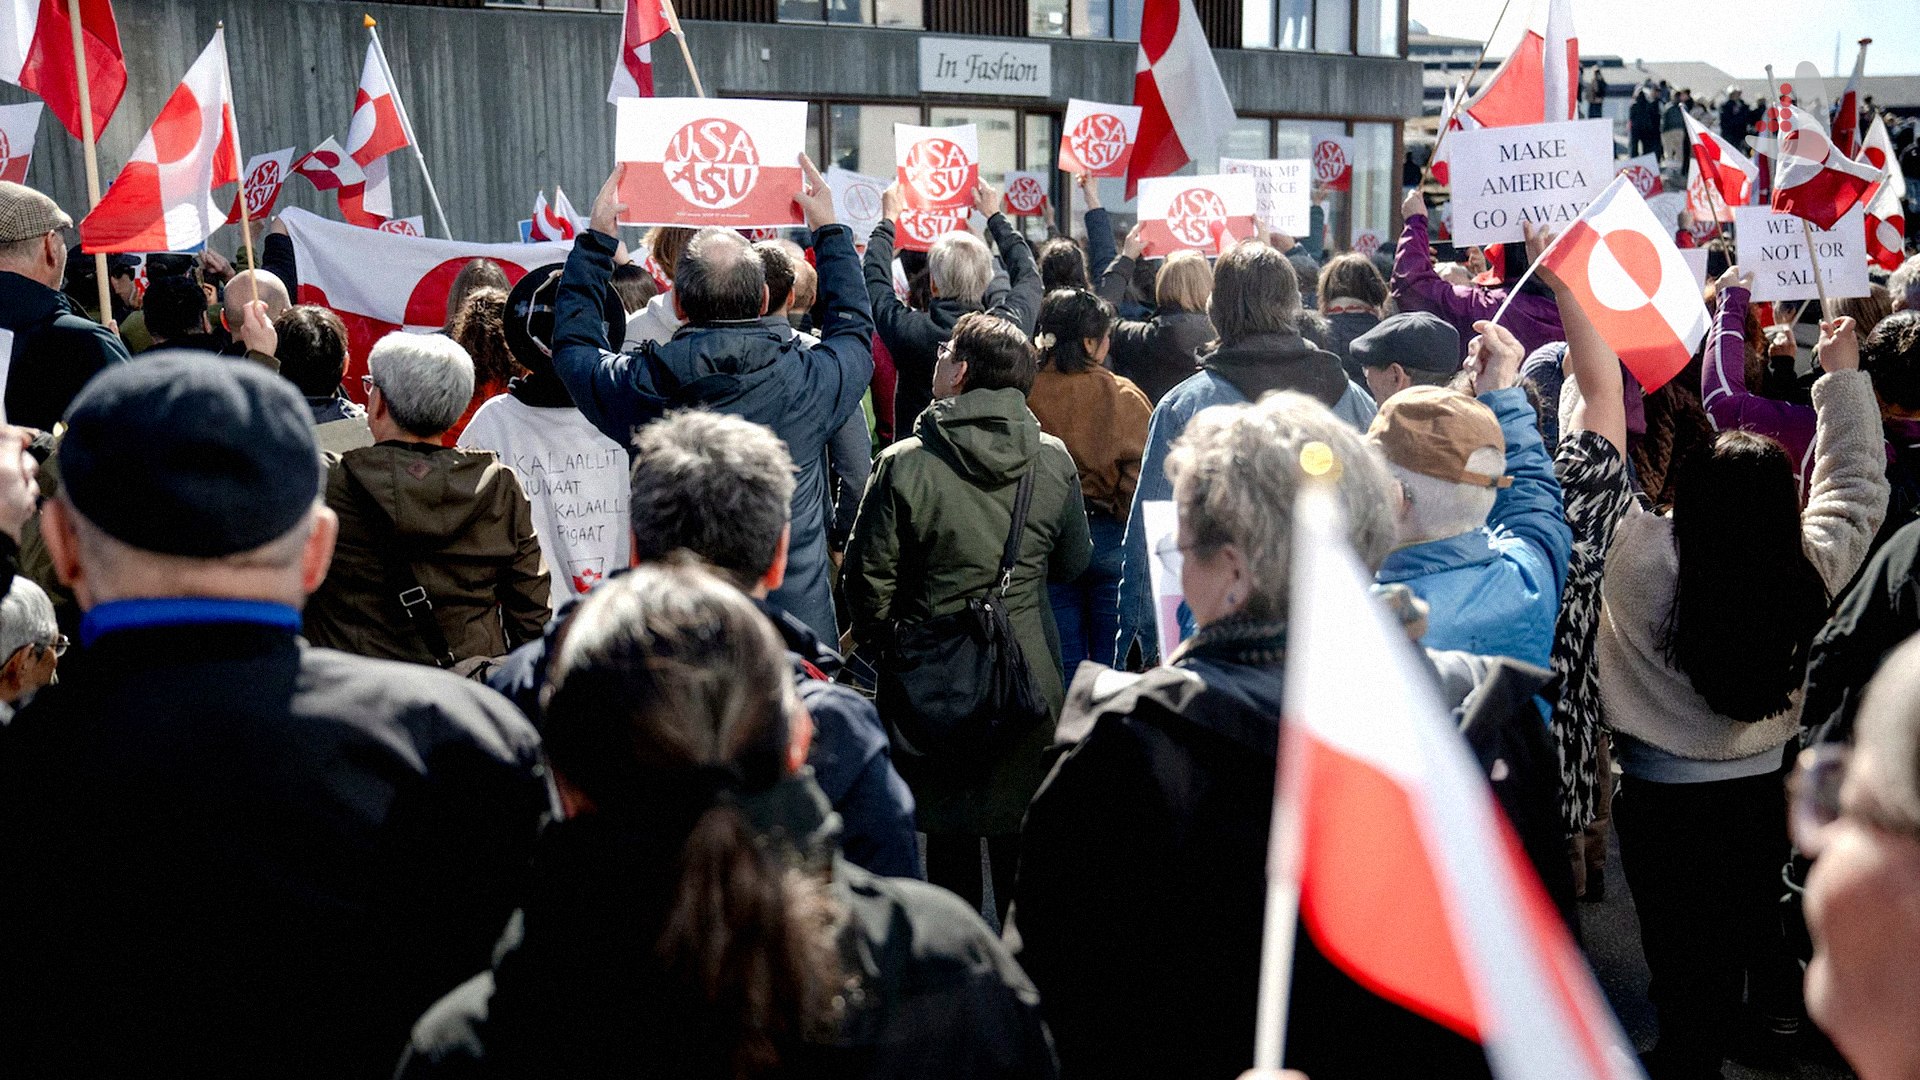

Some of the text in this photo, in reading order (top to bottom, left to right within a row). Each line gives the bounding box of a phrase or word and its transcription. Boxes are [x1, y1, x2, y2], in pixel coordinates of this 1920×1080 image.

[935, 51, 1039, 84] In Fashion
[1078, 115, 1125, 142] USA
[672, 120, 755, 166] USA
[1499, 139, 1567, 163] MAKE
[671, 162, 753, 205] ASU
[1480, 170, 1588, 197] AMERICA
[1472, 208, 1508, 230] GO
[1766, 218, 1796, 235] WE
[1761, 241, 1845, 261] NOT OR
